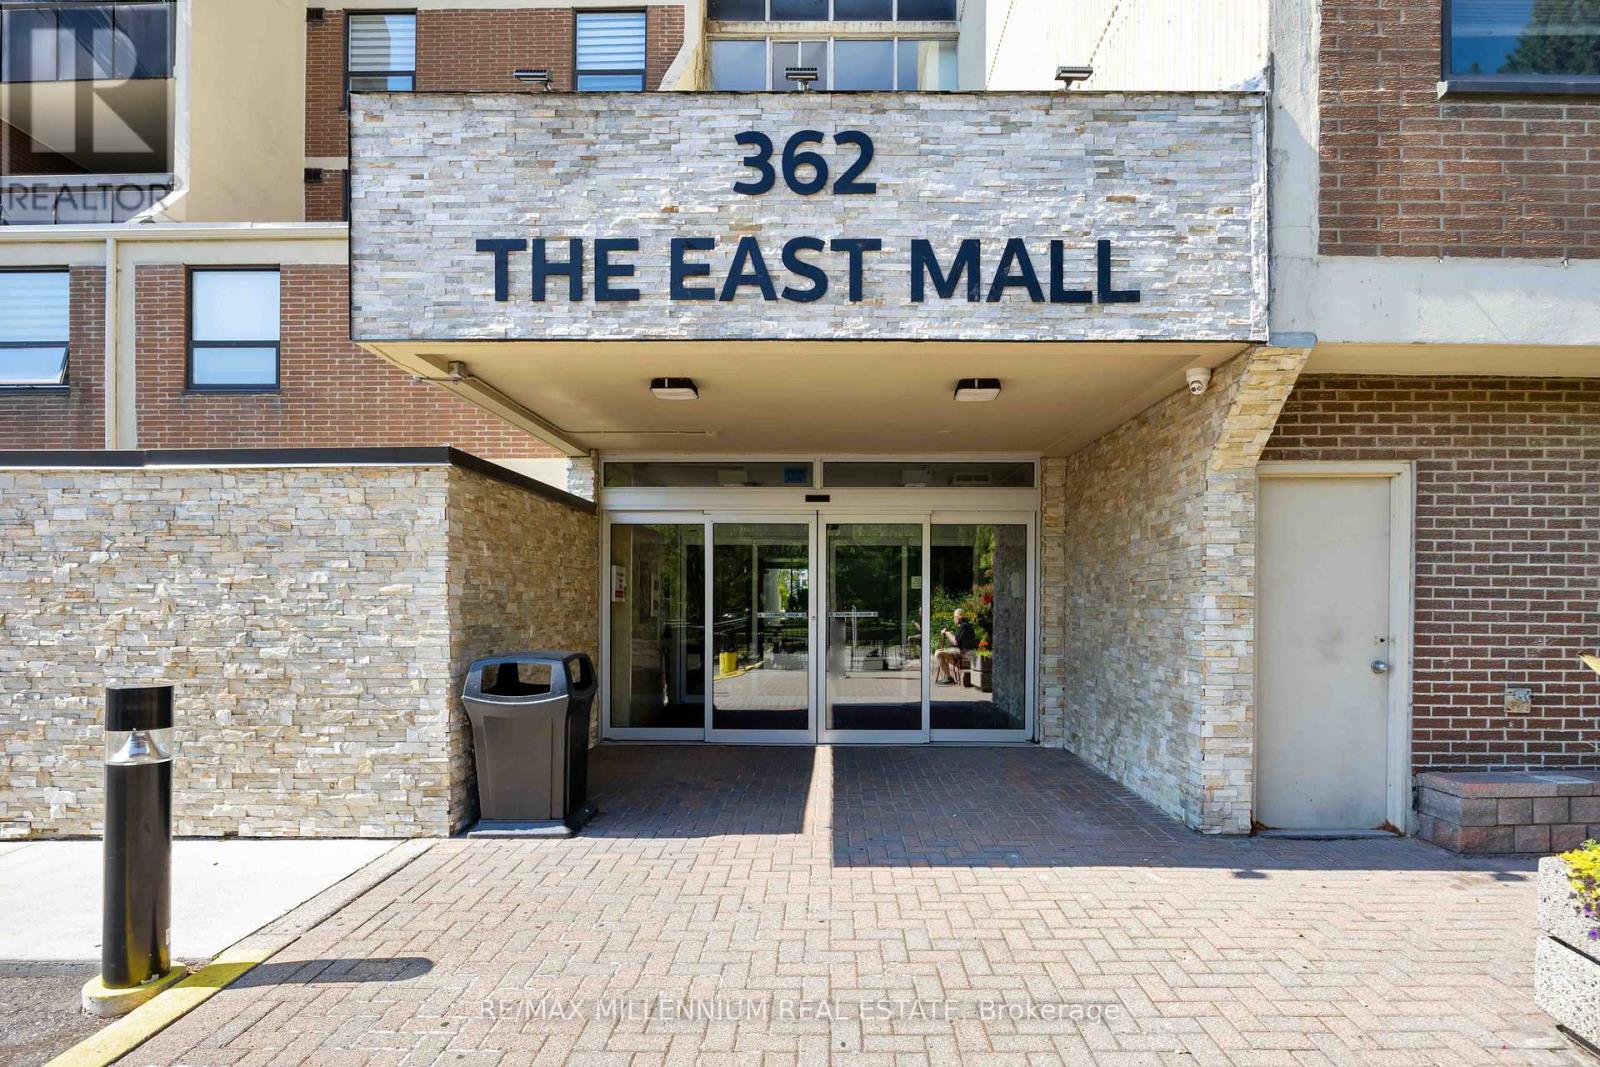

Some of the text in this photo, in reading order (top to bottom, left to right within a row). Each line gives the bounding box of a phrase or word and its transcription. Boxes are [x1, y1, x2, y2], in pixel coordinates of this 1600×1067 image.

[733, 130, 876, 196] 362
[476, 236, 1140, 305] THE EAST MALL
